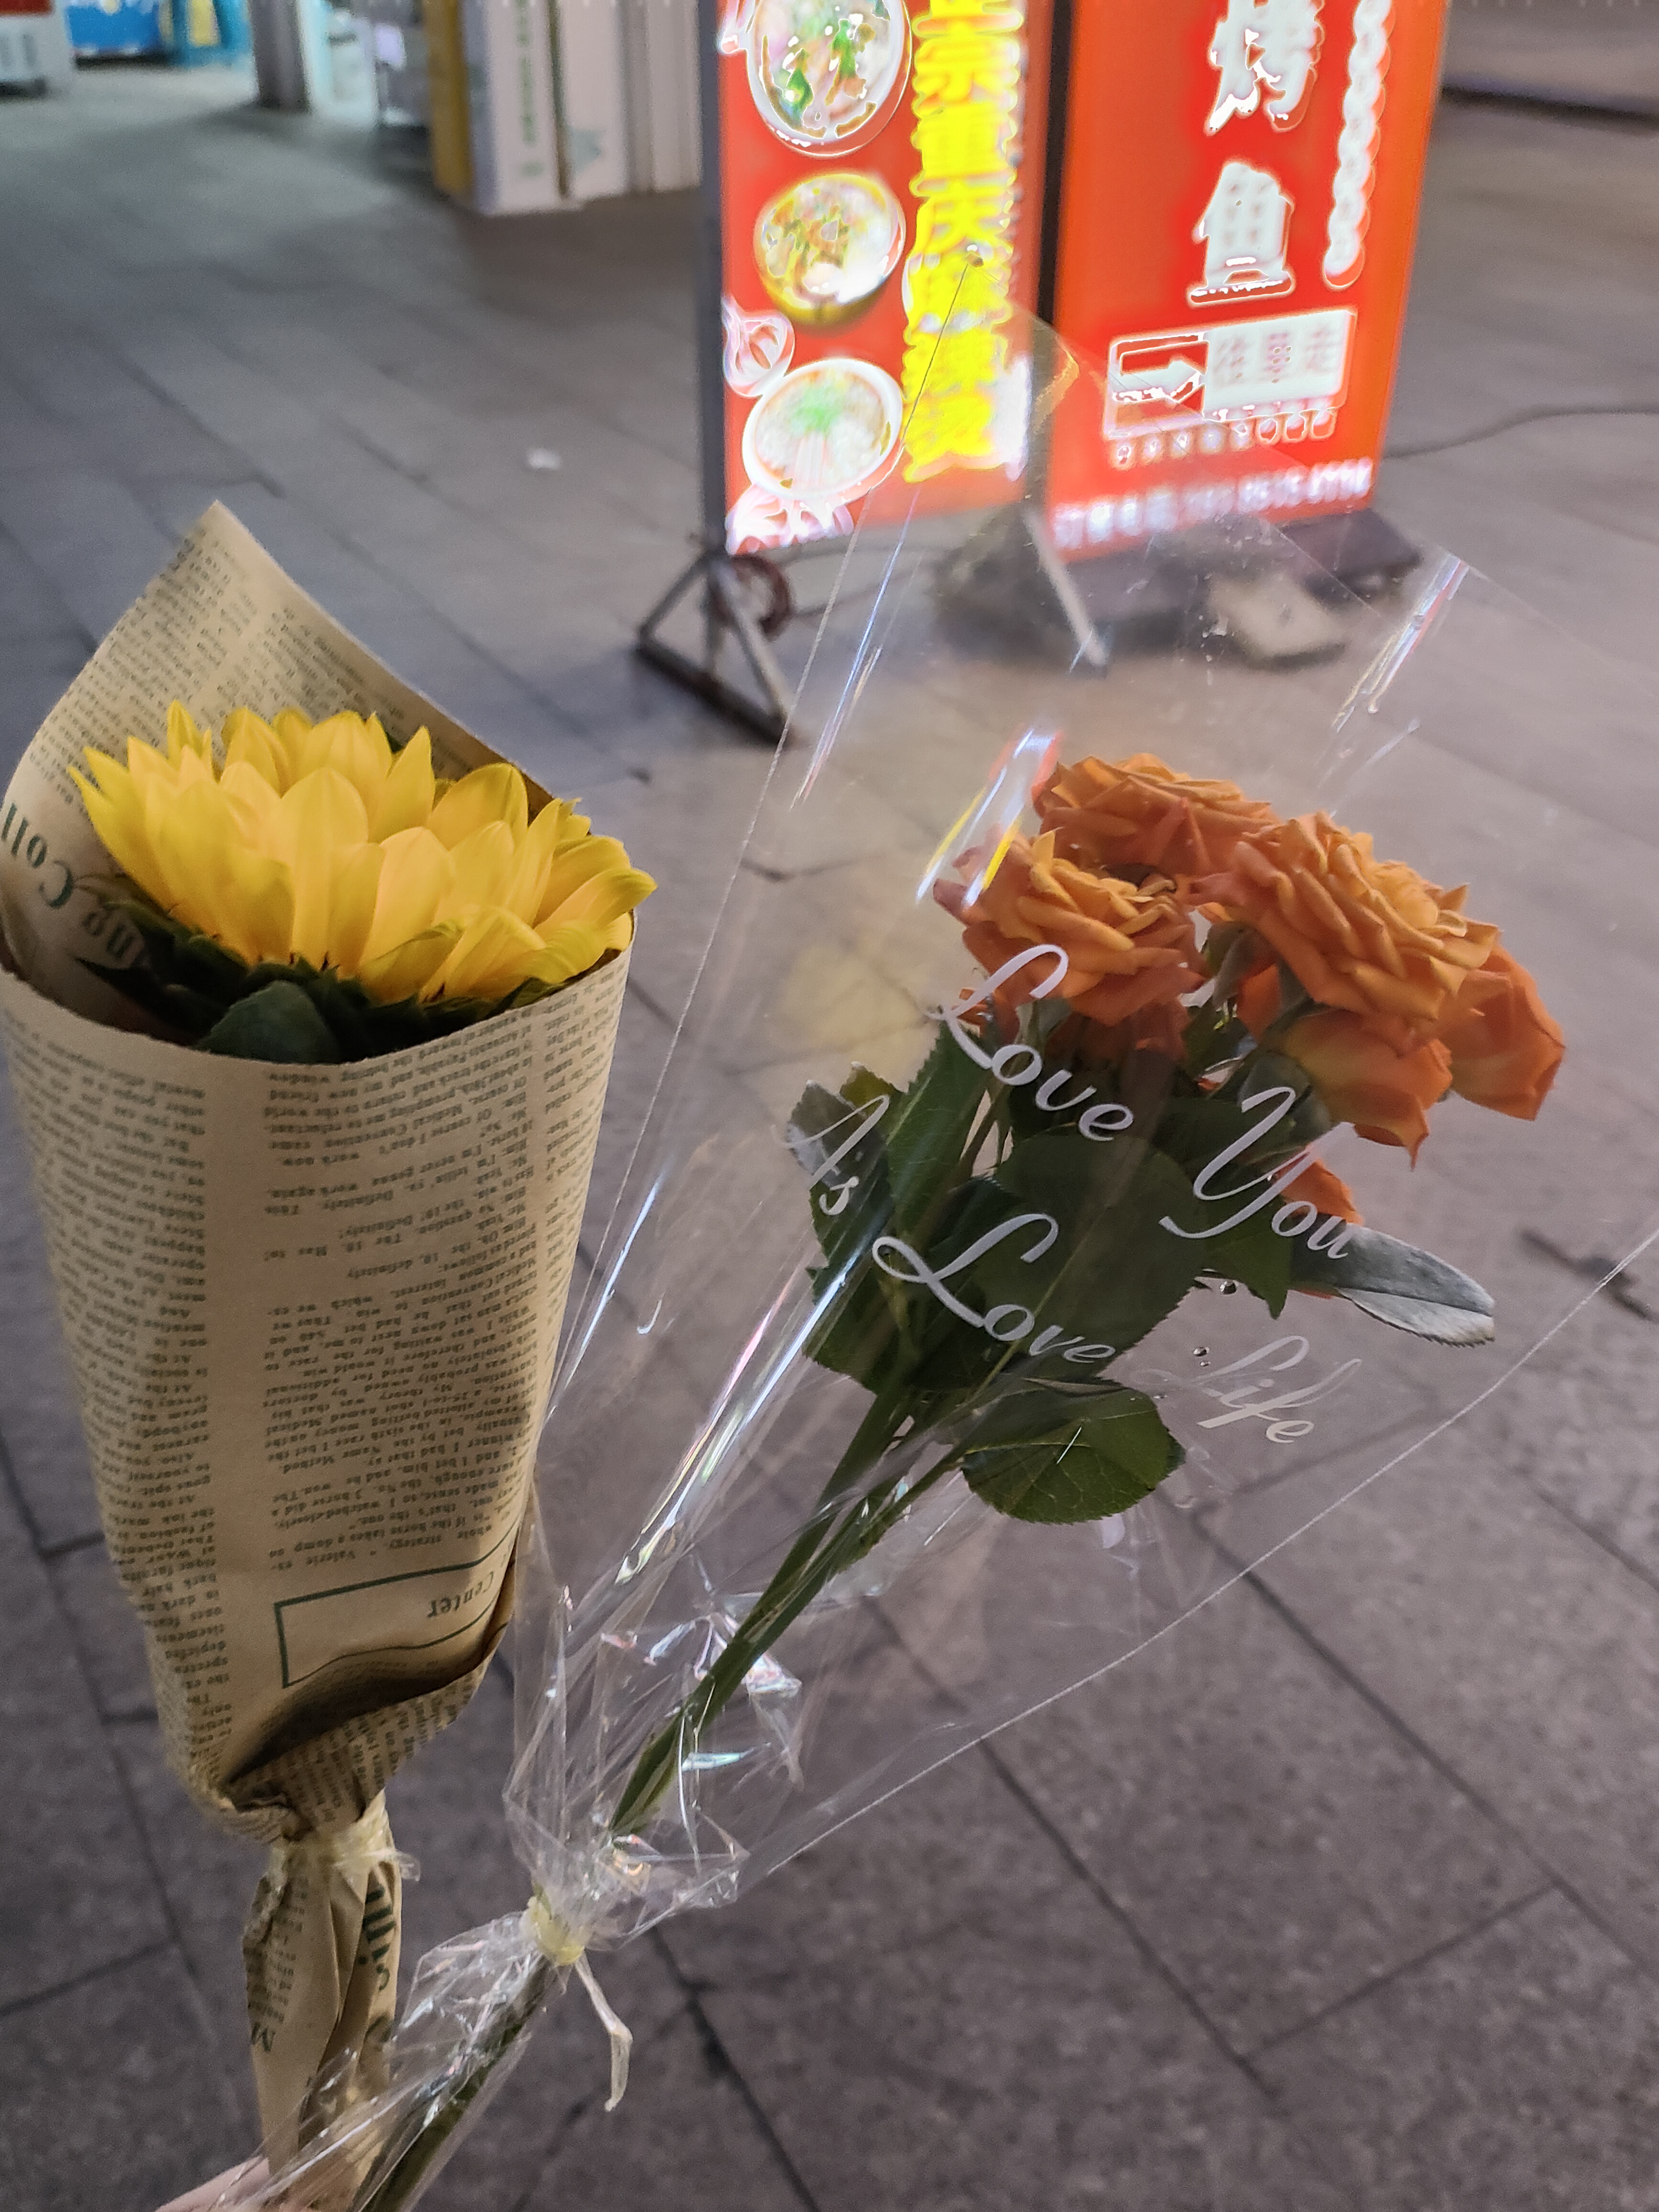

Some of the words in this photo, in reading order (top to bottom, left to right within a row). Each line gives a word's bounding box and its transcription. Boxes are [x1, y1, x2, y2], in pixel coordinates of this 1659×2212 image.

[924, 944, 1134, 1141] Love
[1159, 1086, 1348, 1259] You
[872, 1213, 1116, 1363] Love
